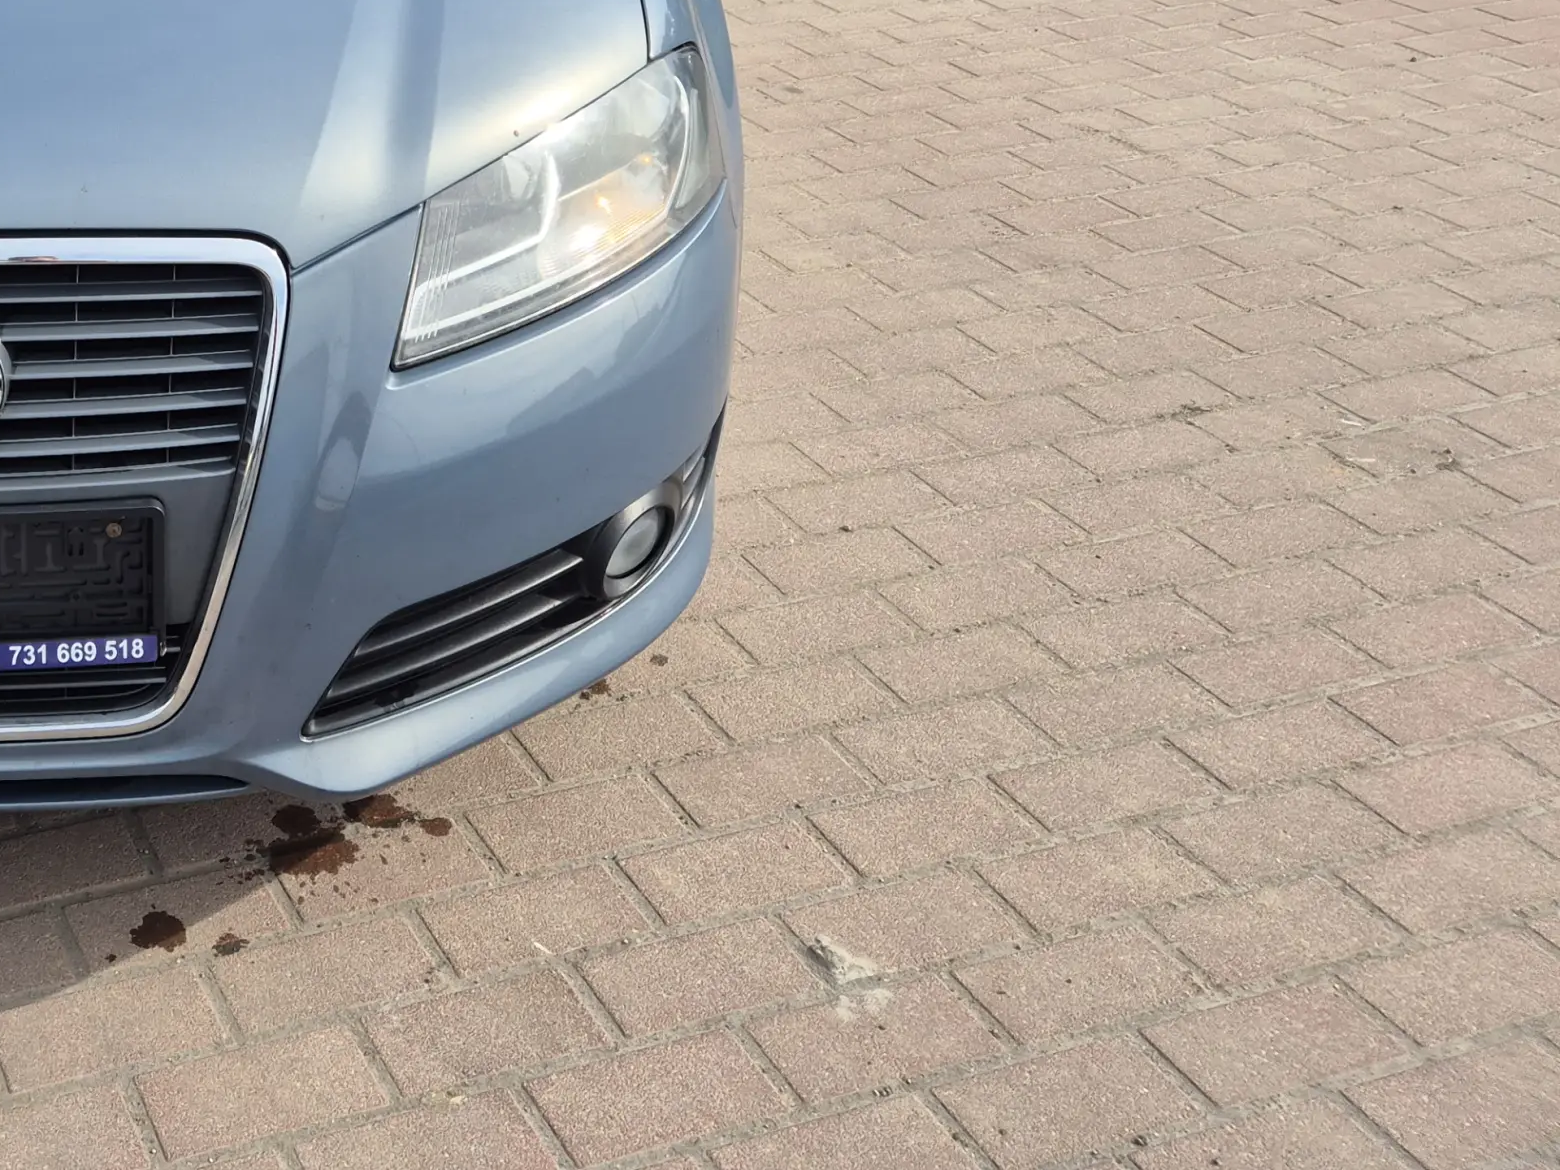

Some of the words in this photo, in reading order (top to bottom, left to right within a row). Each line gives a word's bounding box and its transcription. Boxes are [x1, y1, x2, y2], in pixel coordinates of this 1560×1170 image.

[9, 645, 48, 666] 731
[56, 642, 97, 662] 669
[104, 638, 144, 660] 518
